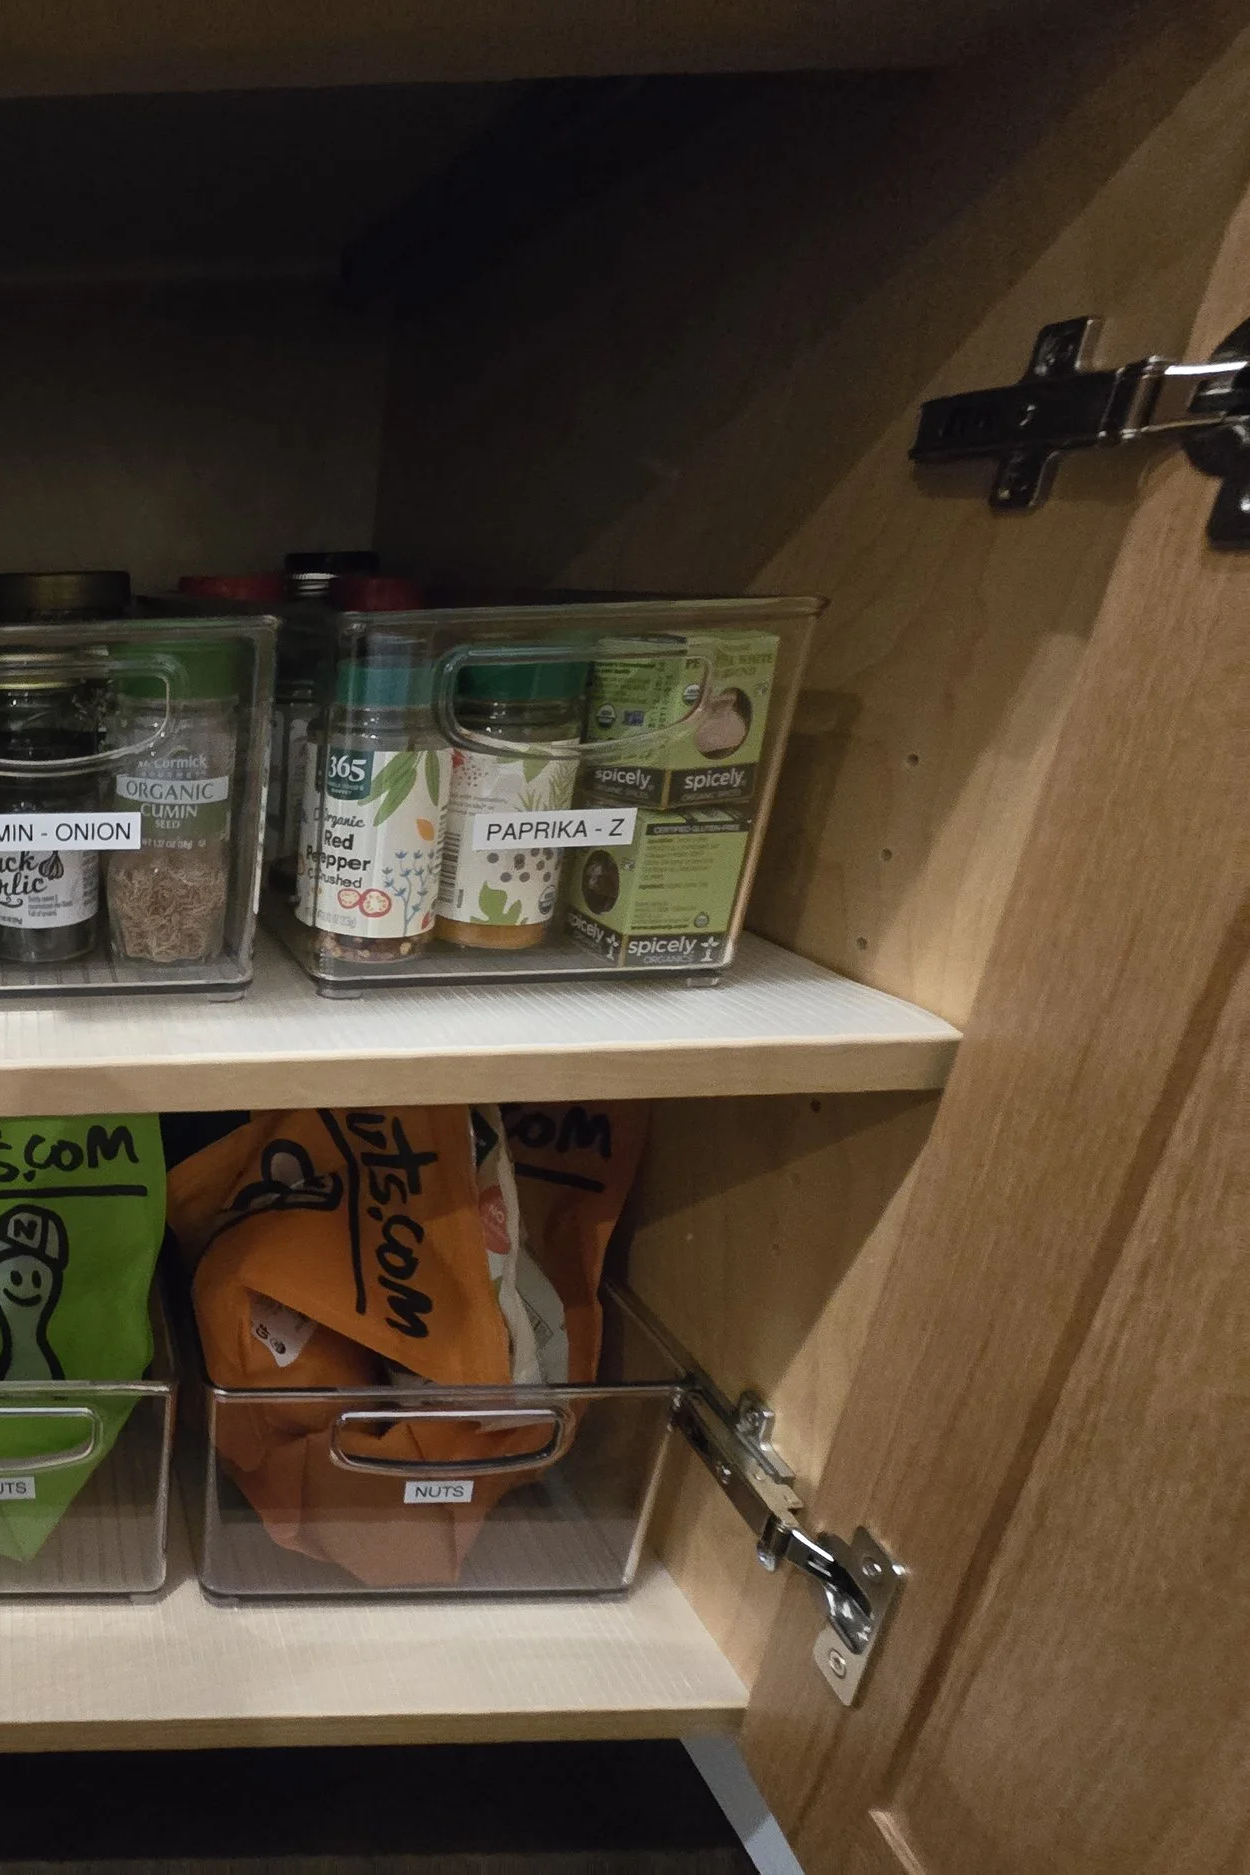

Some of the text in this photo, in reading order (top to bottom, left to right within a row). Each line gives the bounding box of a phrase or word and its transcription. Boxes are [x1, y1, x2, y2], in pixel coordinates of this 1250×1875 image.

[137, 754, 208, 770] McCormick
[327, 754, 367, 782] 365
[594, 767, 651, 790] spicely
[684, 767, 746, 791] spicely
[126, 780, 215, 800] ORGANIC
[140, 803, 198, 819] CUMIN
[313, 807, 366, 829] Organic
[55, 822, 131, 842] ONION
[154, 819, 181, 829] SEED
[486, 820, 588, 841] PAPRIKA
[608, 818, 625, 837] Z
[324, 829, 355, 851] Red
[306, 844, 372, 872] Pepper
[308, 867, 363, 889] Crushed
[627, 935, 698, 957] spicely
[346, 1111, 439, 1339] uts.com
[415, 1485, 465, 1498] NUTS
